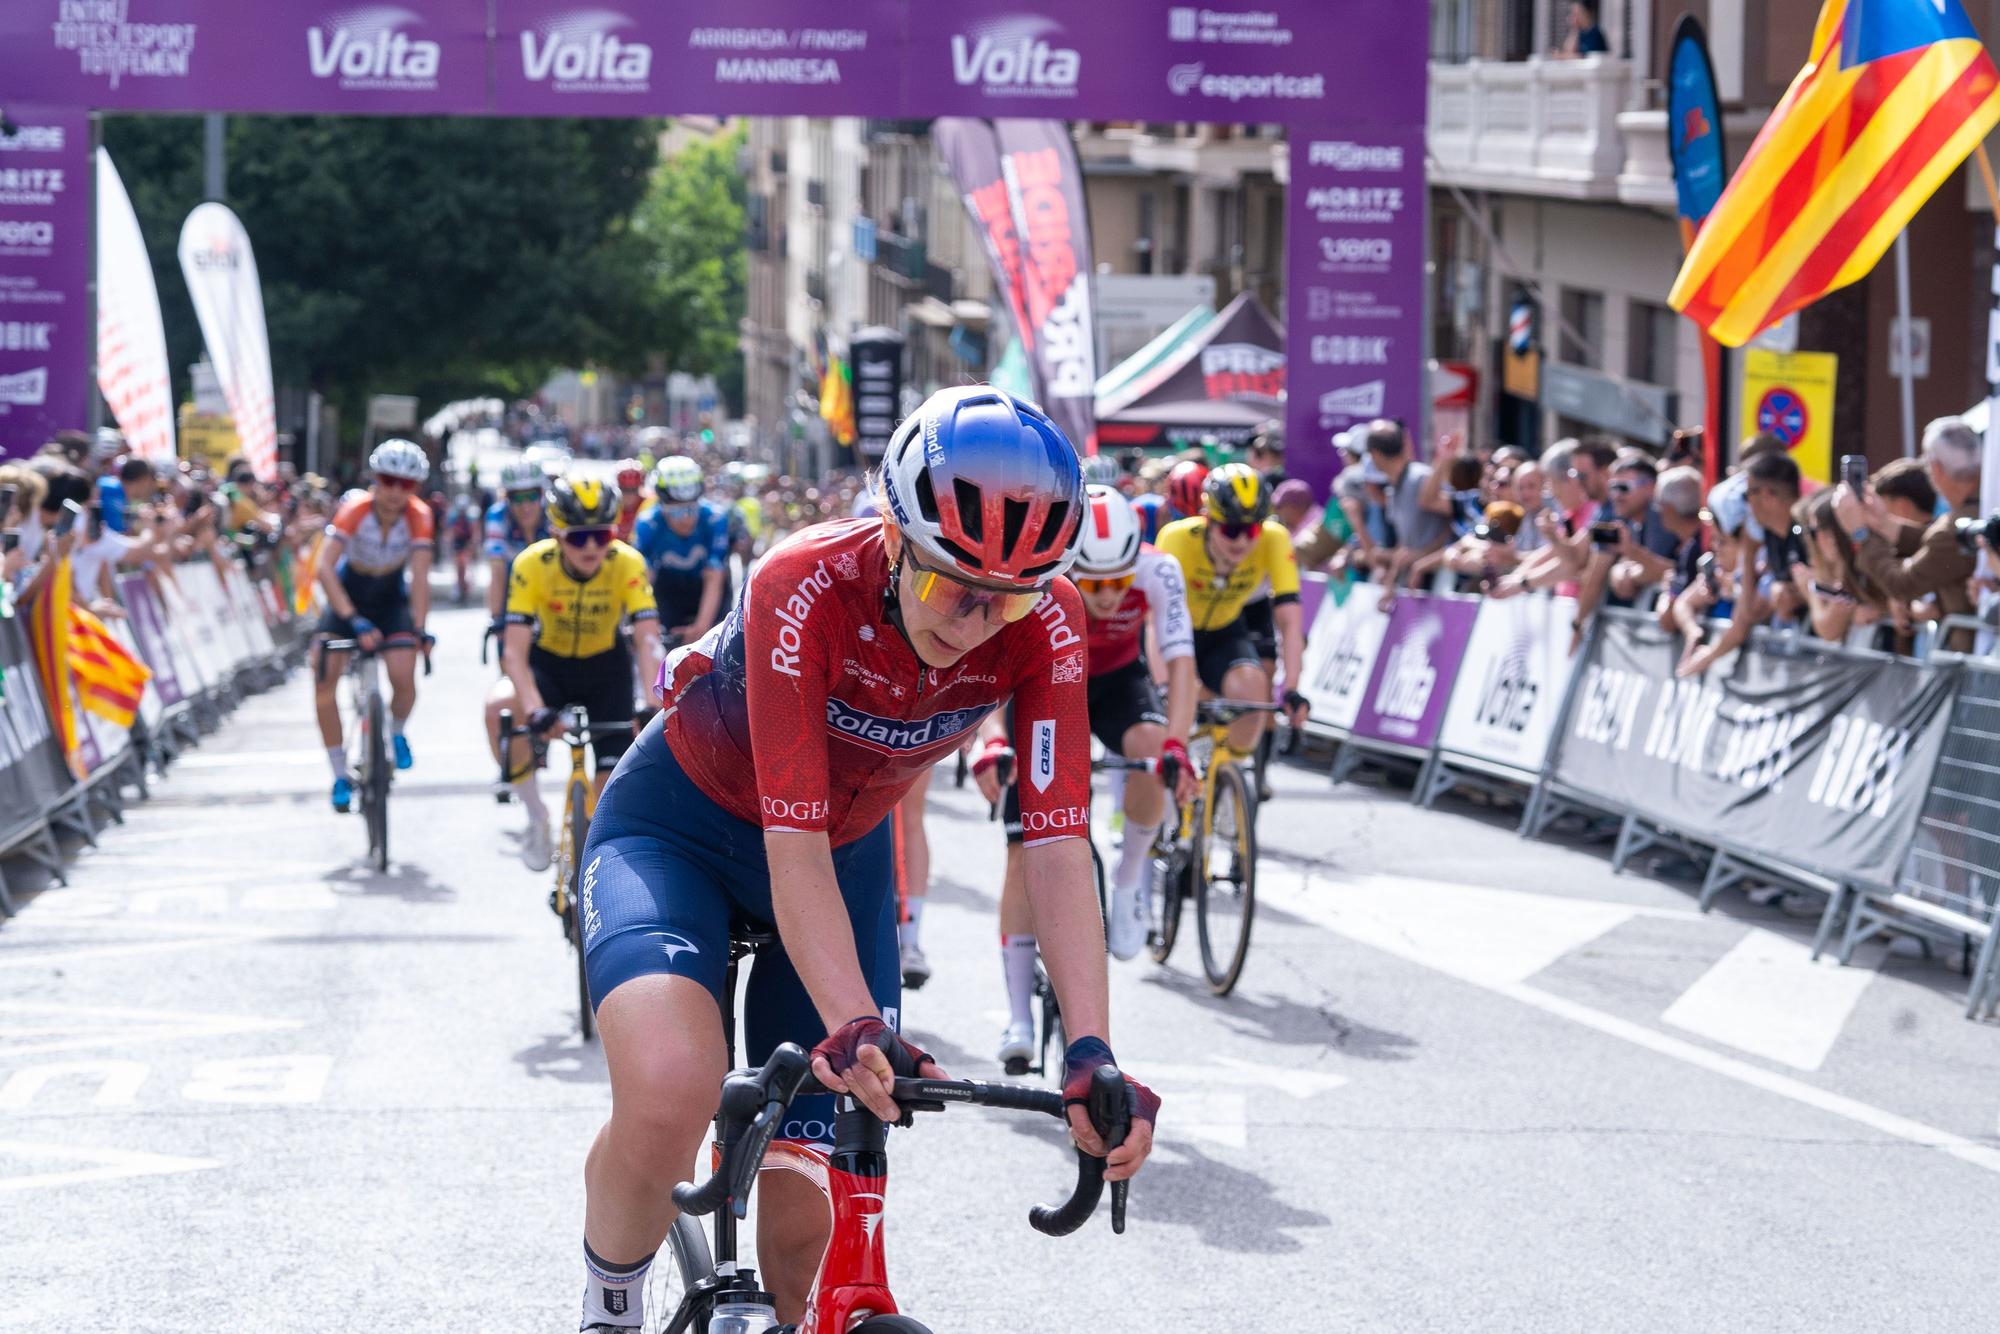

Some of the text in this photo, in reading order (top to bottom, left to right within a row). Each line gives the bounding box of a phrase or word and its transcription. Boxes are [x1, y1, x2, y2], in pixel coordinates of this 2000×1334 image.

[307, 26, 442, 77] Volta
[520, 29, 653, 81] Volta
[715, 57, 841, 84] MANRESA
[951, 34, 1081, 85] Volta
[1305, 187, 1404, 211] MORITZ
[771, 560, 833, 677] Roland
[827, 700, 932, 746] Roland
[922, 1086, 972, 1097] HAMMERHEAD
